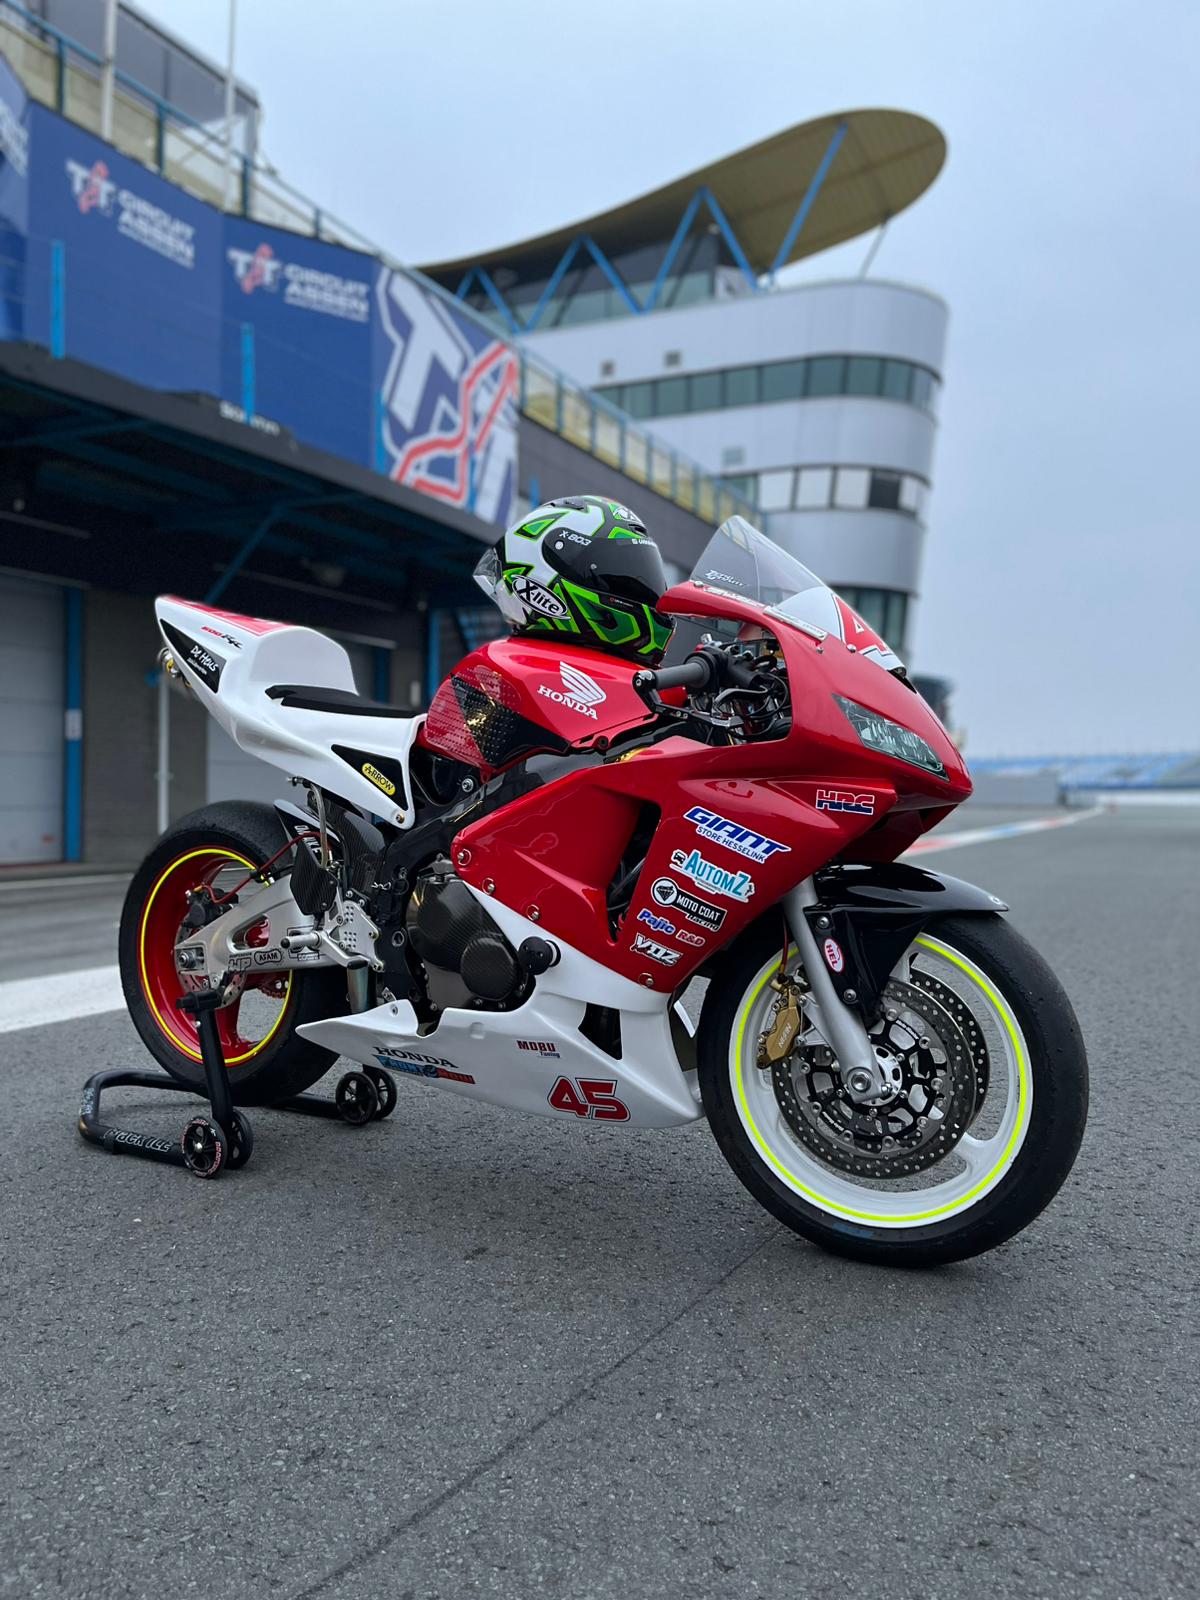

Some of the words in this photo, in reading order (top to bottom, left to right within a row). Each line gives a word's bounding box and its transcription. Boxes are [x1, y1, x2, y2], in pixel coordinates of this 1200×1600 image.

[516, 579, 561, 614] X-lite
[537, 684, 598, 720] HONDA
[364, 765, 394, 791] ARROW
[816, 789, 875, 815] HRC
[684, 807, 790, 854] GIANT
[697, 826, 721, 844] STORE
[722, 838, 766, 862] HESSELINK
[677, 895, 699, 912] MOTO
[700, 905, 721, 921] COAT
[638, 909, 675, 934] Pajic
[677, 930, 705, 946] R&D
[259, 951, 279, 961] AFAM
[825, 944, 838, 967] HEL
[373, 1046, 459, 1068] HONDA
[547, 1075, 631, 1122] 45
